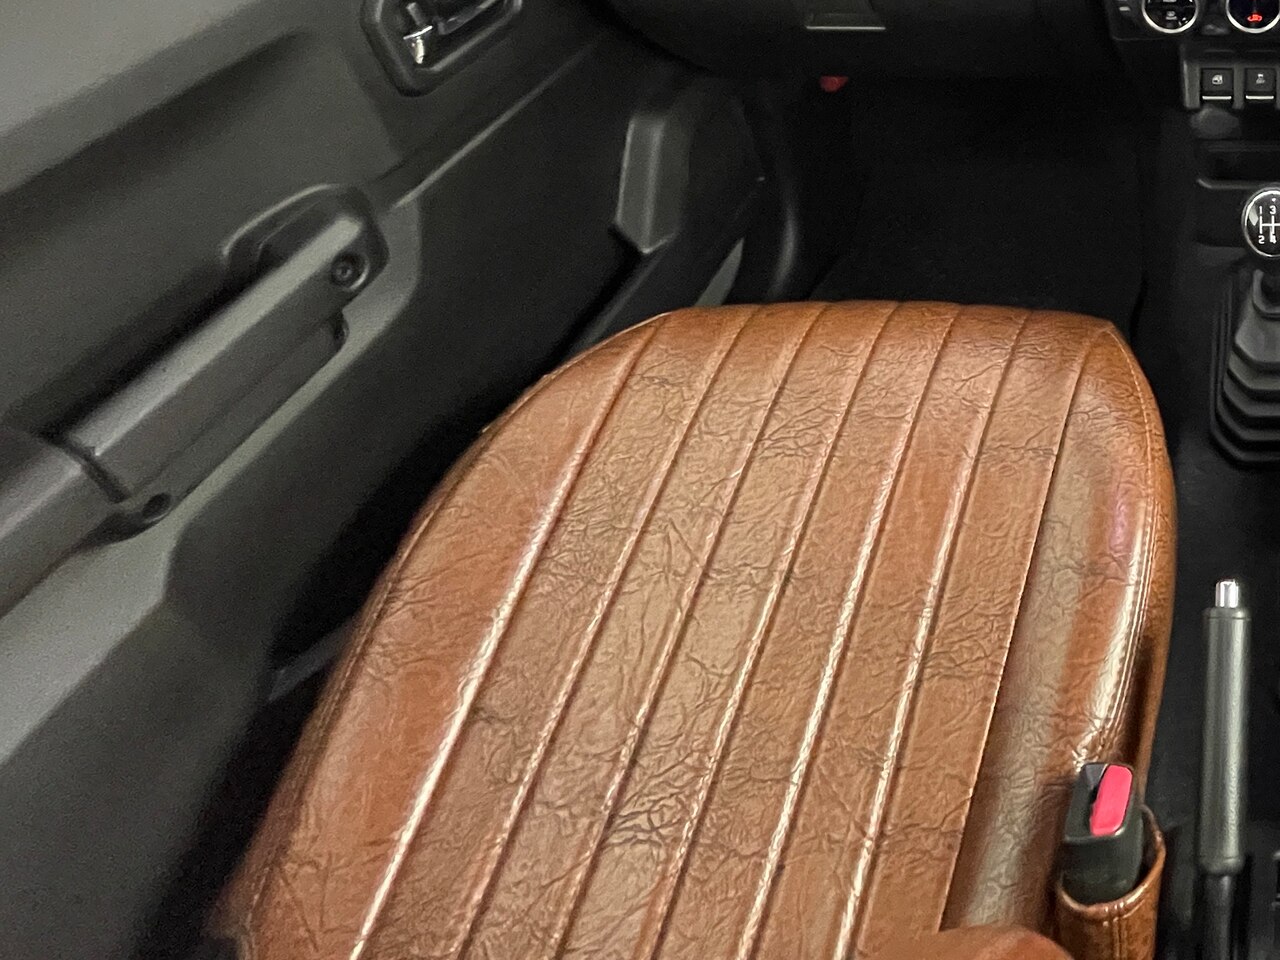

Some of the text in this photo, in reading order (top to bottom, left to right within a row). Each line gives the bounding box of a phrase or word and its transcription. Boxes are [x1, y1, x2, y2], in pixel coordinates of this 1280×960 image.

[1258, 205, 1263, 215] 1
[1269, 205, 1277, 215] 3
[1258, 235, 1265, 244] 2
[1269, 234, 1277, 244] 4
